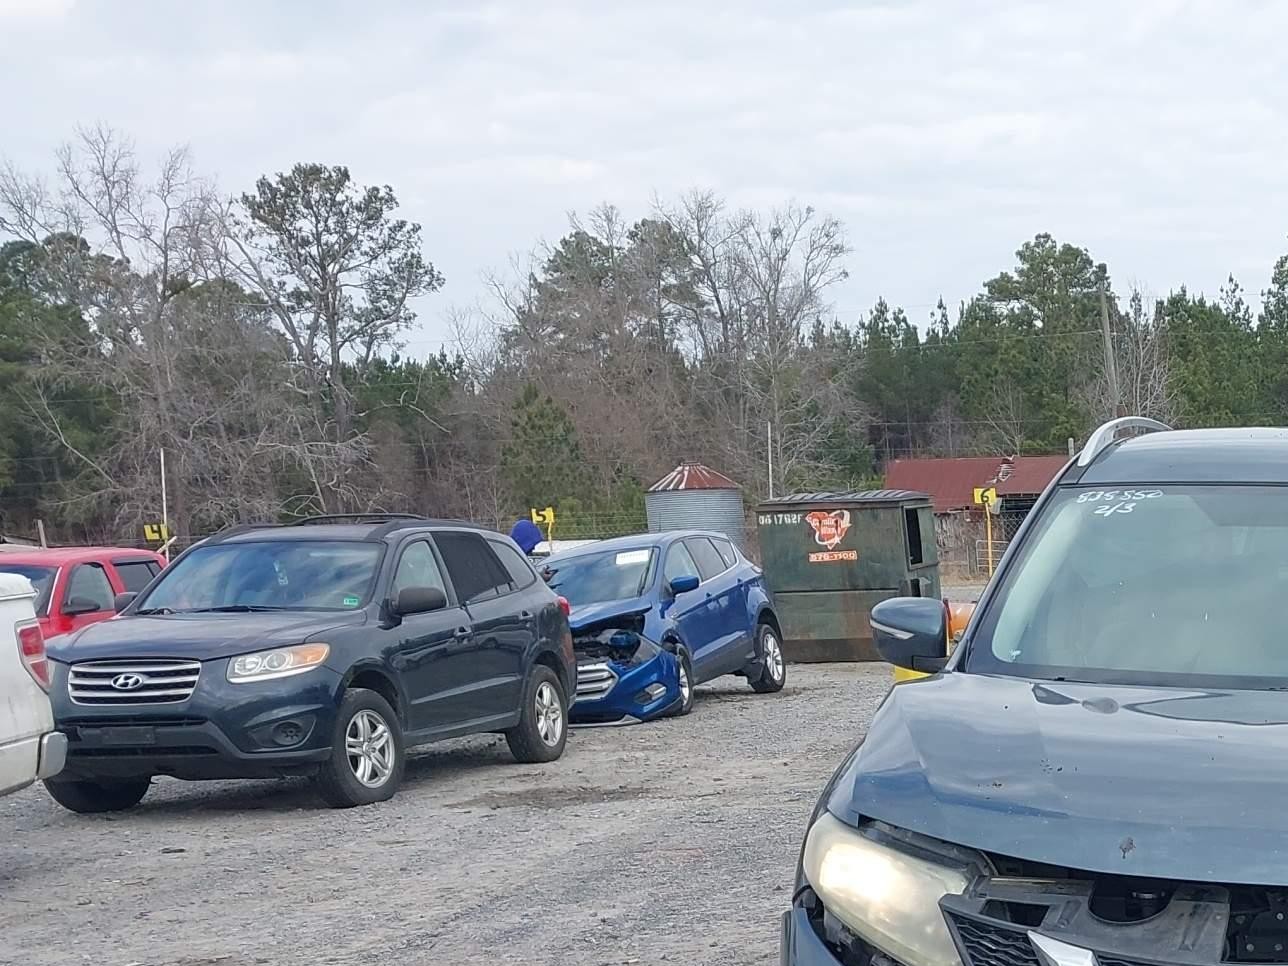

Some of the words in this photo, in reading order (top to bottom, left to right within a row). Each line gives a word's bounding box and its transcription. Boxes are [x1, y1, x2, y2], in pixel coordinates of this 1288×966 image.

[980, 487, 991, 504] 6
[534, 507, 547, 524] 5
[1093, 501, 1137, 517] 2/3
[149, 523, 163, 541] 4
